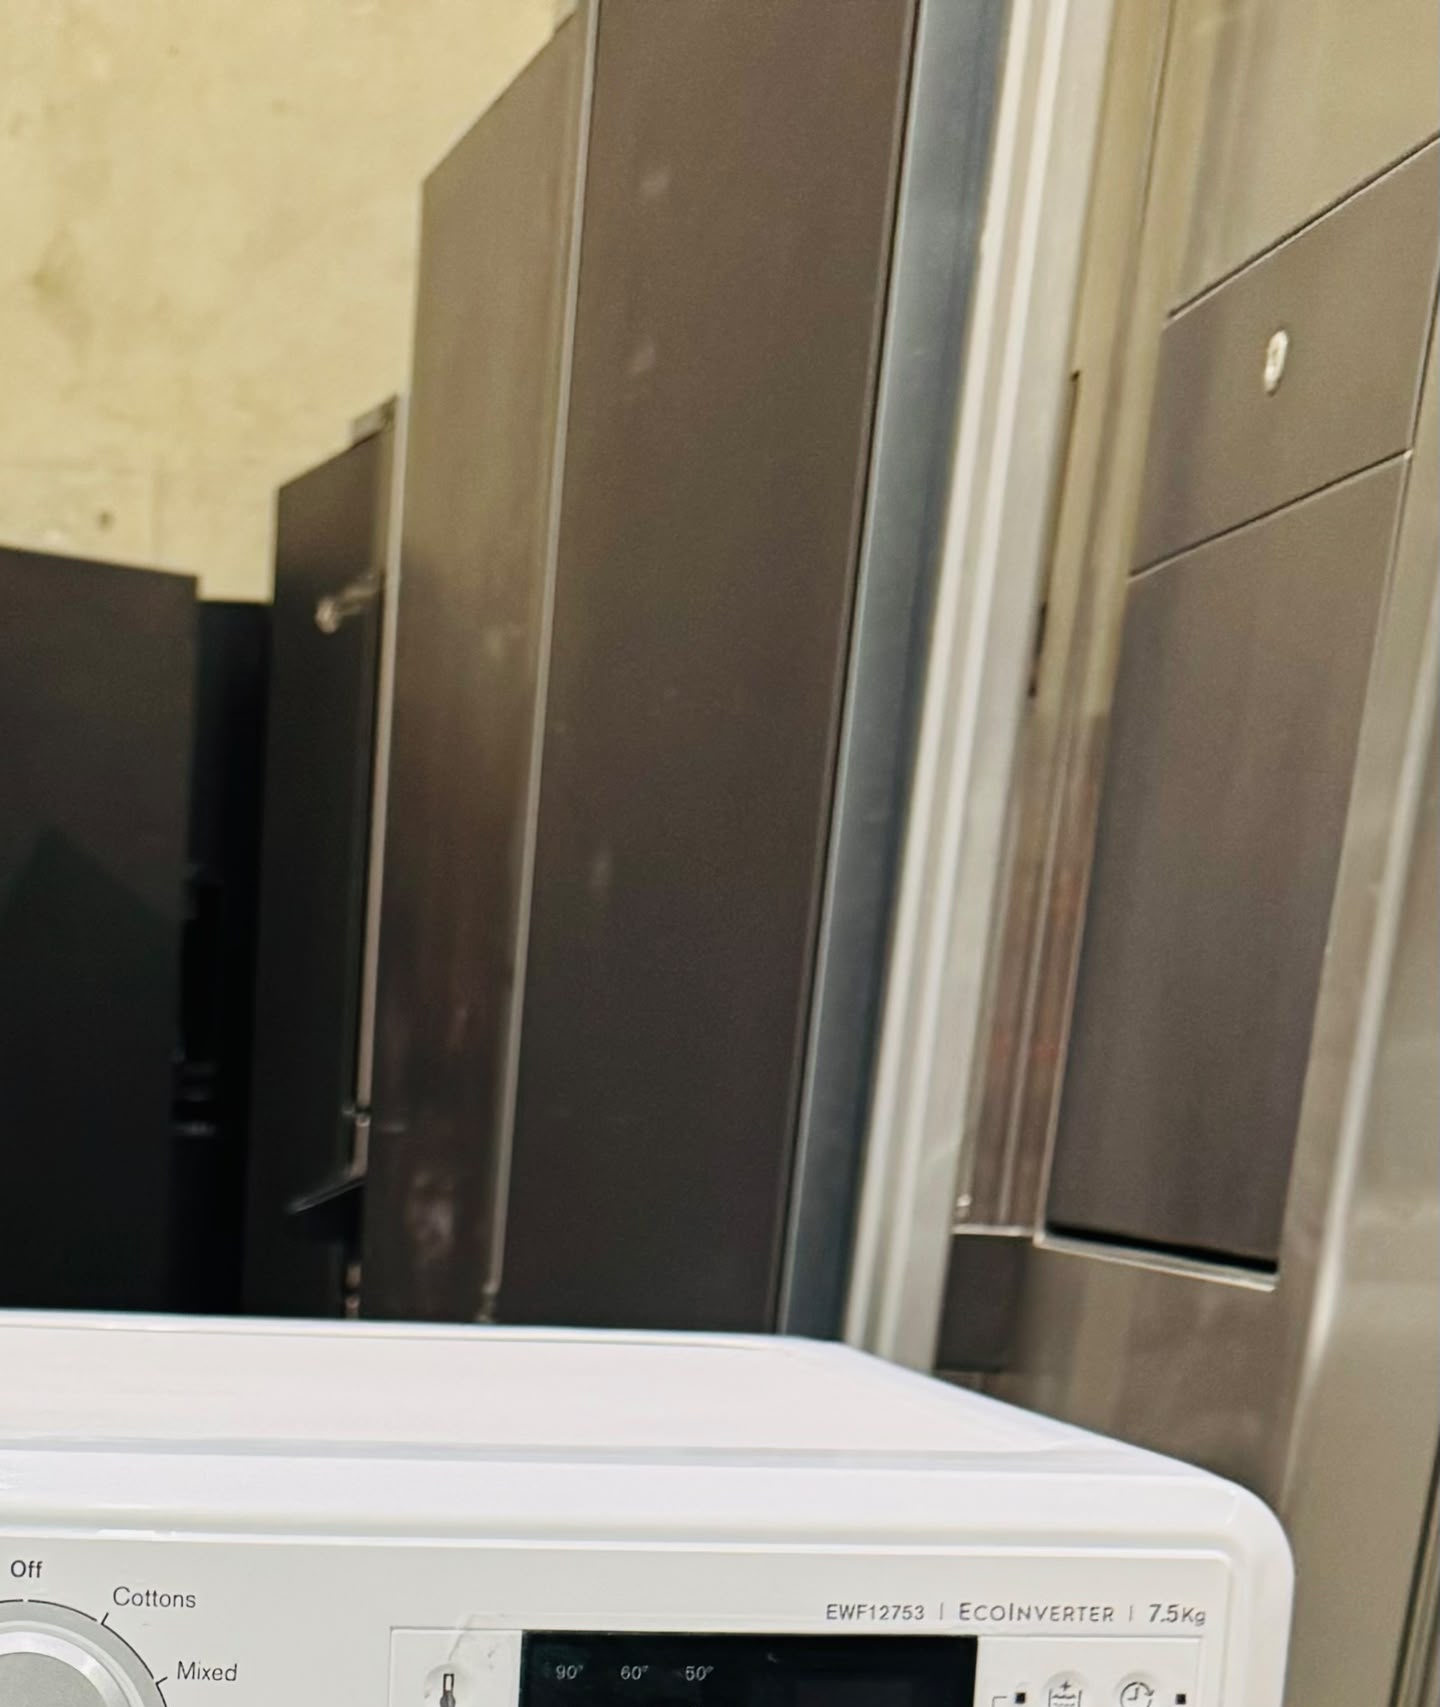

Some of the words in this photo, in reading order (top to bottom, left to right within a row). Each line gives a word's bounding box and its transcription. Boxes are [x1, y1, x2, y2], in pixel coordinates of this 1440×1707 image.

[10, 1560, 42, 1579] Off
[112, 1586, 196, 1608] Cottons
[826, 1604, 925, 1621] EWF12753
[177, 1661, 238, 1682] Mixed
